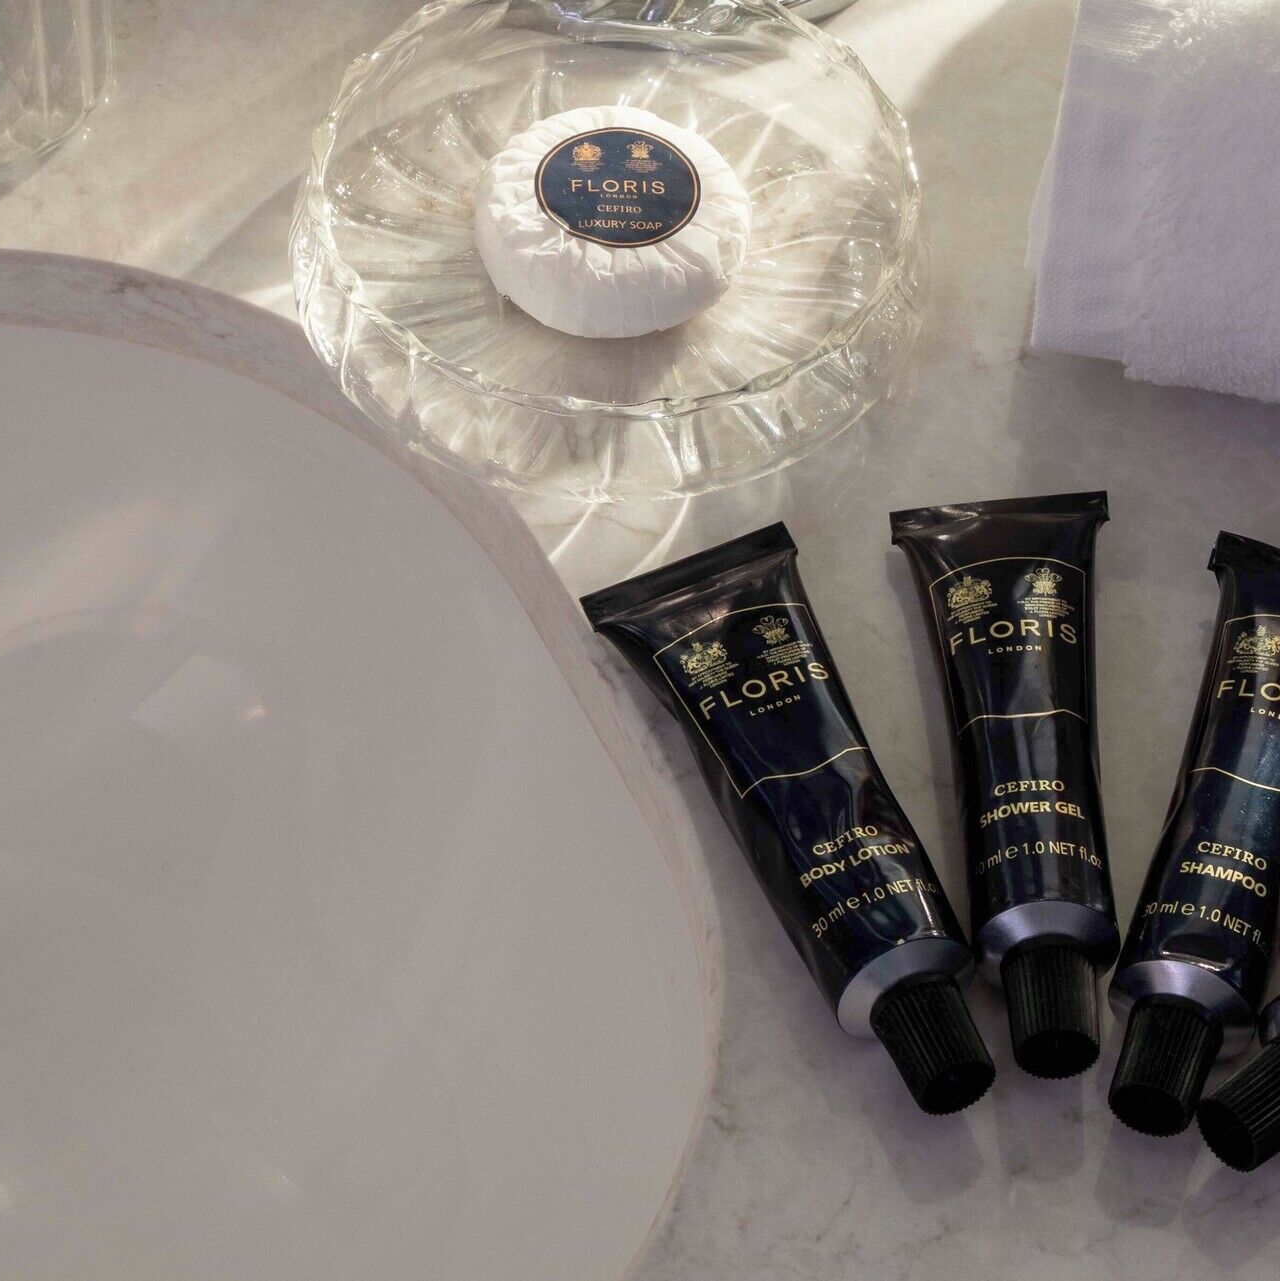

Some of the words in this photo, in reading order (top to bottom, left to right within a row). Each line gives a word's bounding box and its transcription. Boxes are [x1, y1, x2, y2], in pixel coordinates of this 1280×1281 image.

[571, 179, 665, 194] FLORIS
[597, 204, 642, 214] CEFIRO
[578, 219, 627, 229] LUXURY
[629, 220, 663, 230] SOAP
[949, 618, 1078, 657] FLORIS
[988, 645, 1042, 655] LONDON
[698, 662, 830, 721] FLORIS
[749, 694, 802, 716] LONDON
[994, 779, 1065, 797] CEFIRO
[979, 801, 1052, 829] SHOWER
[1055, 801, 1086, 820] GEL
[812, 825, 878, 856] CEFIRO
[986, 849, 1002, 869] ml
[1022, 841, 1045, 855] 1.0
[1049, 841, 1076, 857] NET
[799, 860, 847, 888] BODY
[849, 843, 910, 867] LOTION
[1197, 841, 1268, 871] CEFIRO
[1179, 861, 1268, 897] SHAMPOO
[812, 917, 828, 939] 30
[828, 901, 846, 921] ml
[862, 886, 886, 904] 1.0
[886, 879, 914, 895] NET
[1159, 900, 1179, 914] ml
[1199, 905, 1222, 923] 1.0
[1223, 913, 1252, 936] NET
